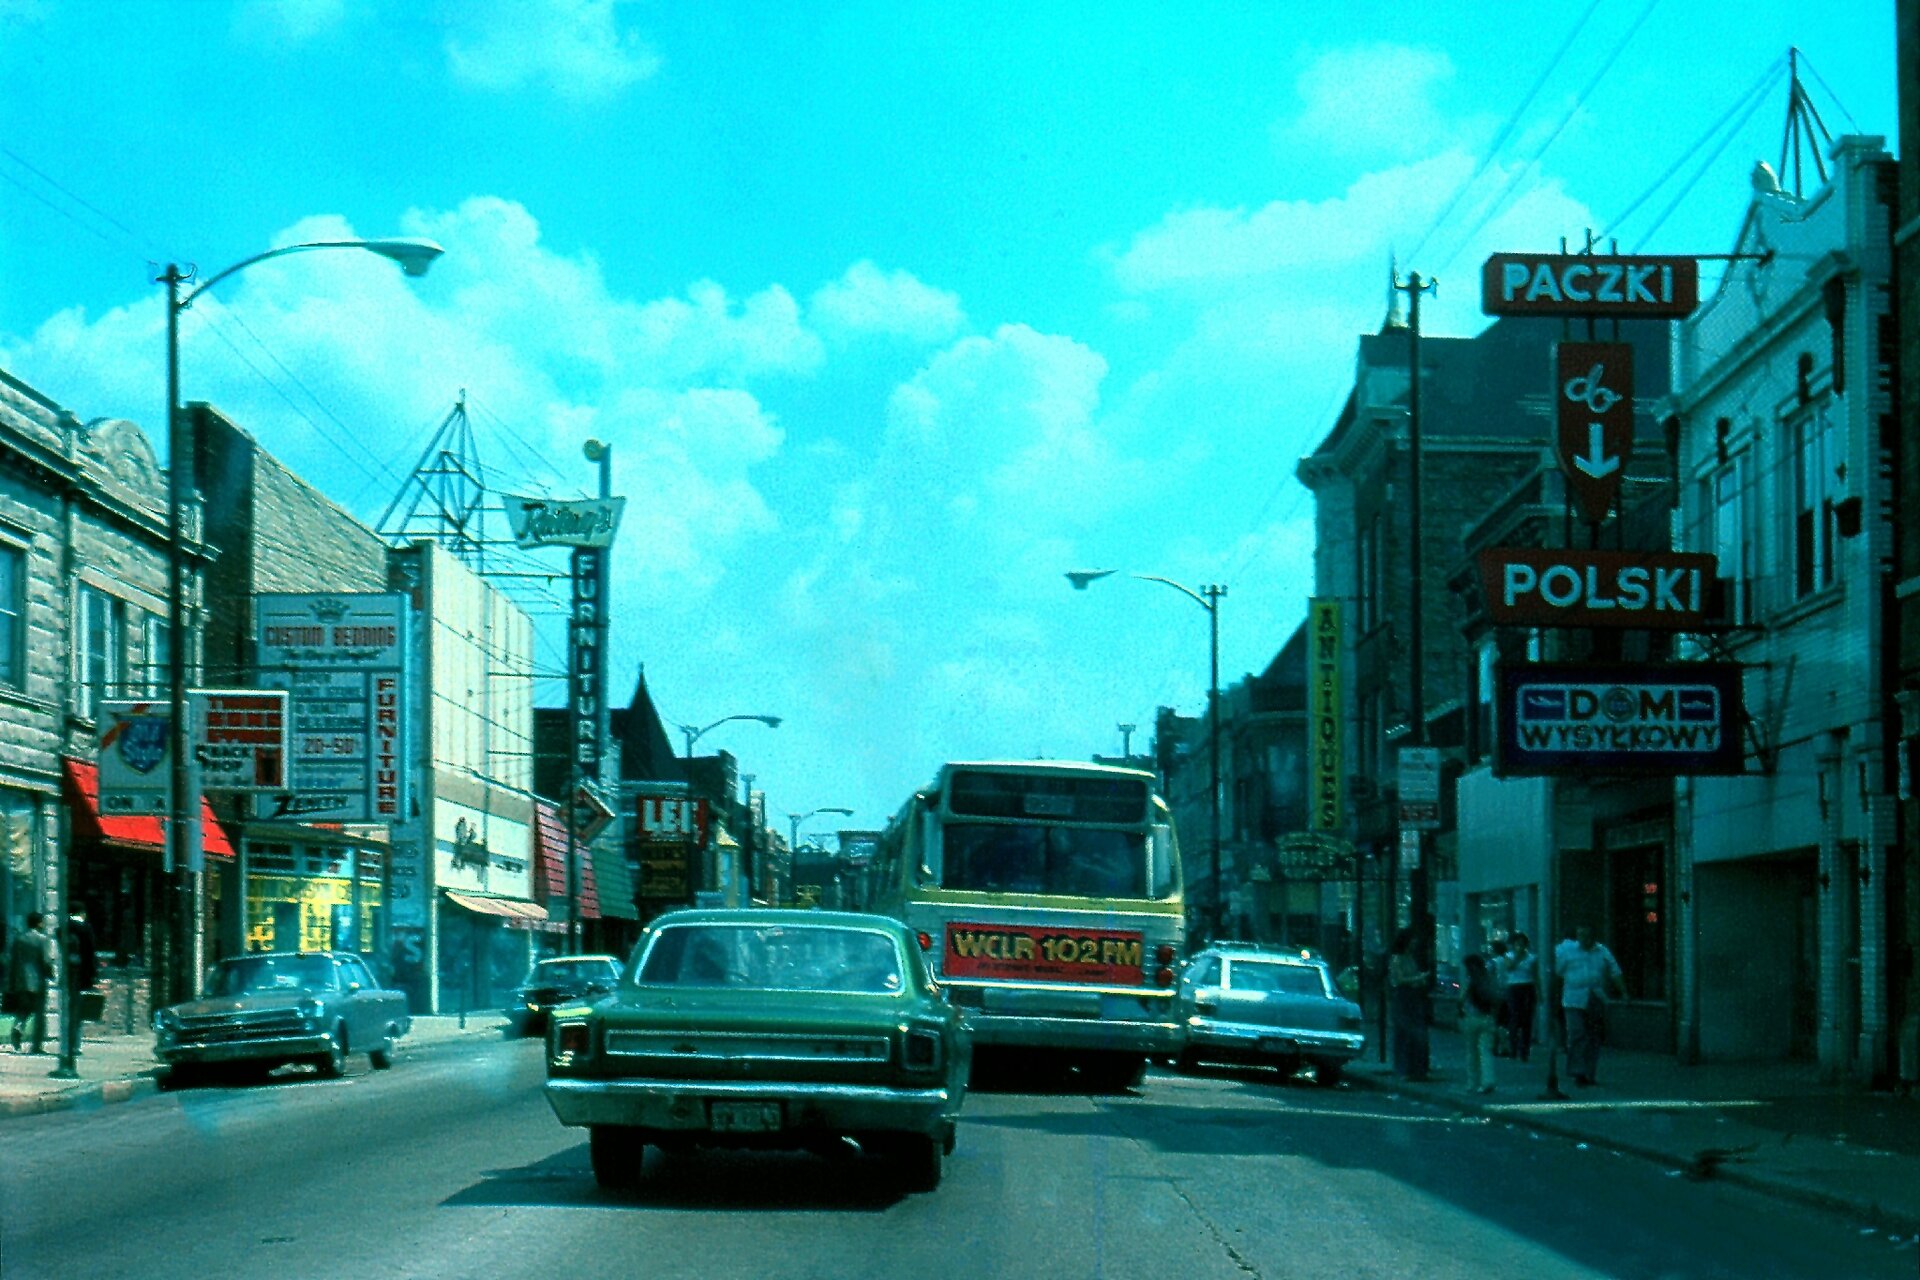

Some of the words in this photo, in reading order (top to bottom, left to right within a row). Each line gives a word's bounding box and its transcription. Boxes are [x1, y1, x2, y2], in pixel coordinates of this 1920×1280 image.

[1501, 261, 1675, 305] PACZKI
[1503, 563, 1702, 613] POLSKI
[333, 626, 397, 647] BEDDING
[577, 555, 597, 763] FURNITURE
[1317, 608, 1337, 829] ANTIQUES
[1569, 688, 1675, 722] DOM
[376, 677, 398, 814] FURNITURE
[272, 795, 353, 818] ZENITH
[951, 929, 1036, 961] WCLR
[1040, 934, 1099, 965] 102
[1102, 937, 1142, 968] FM
